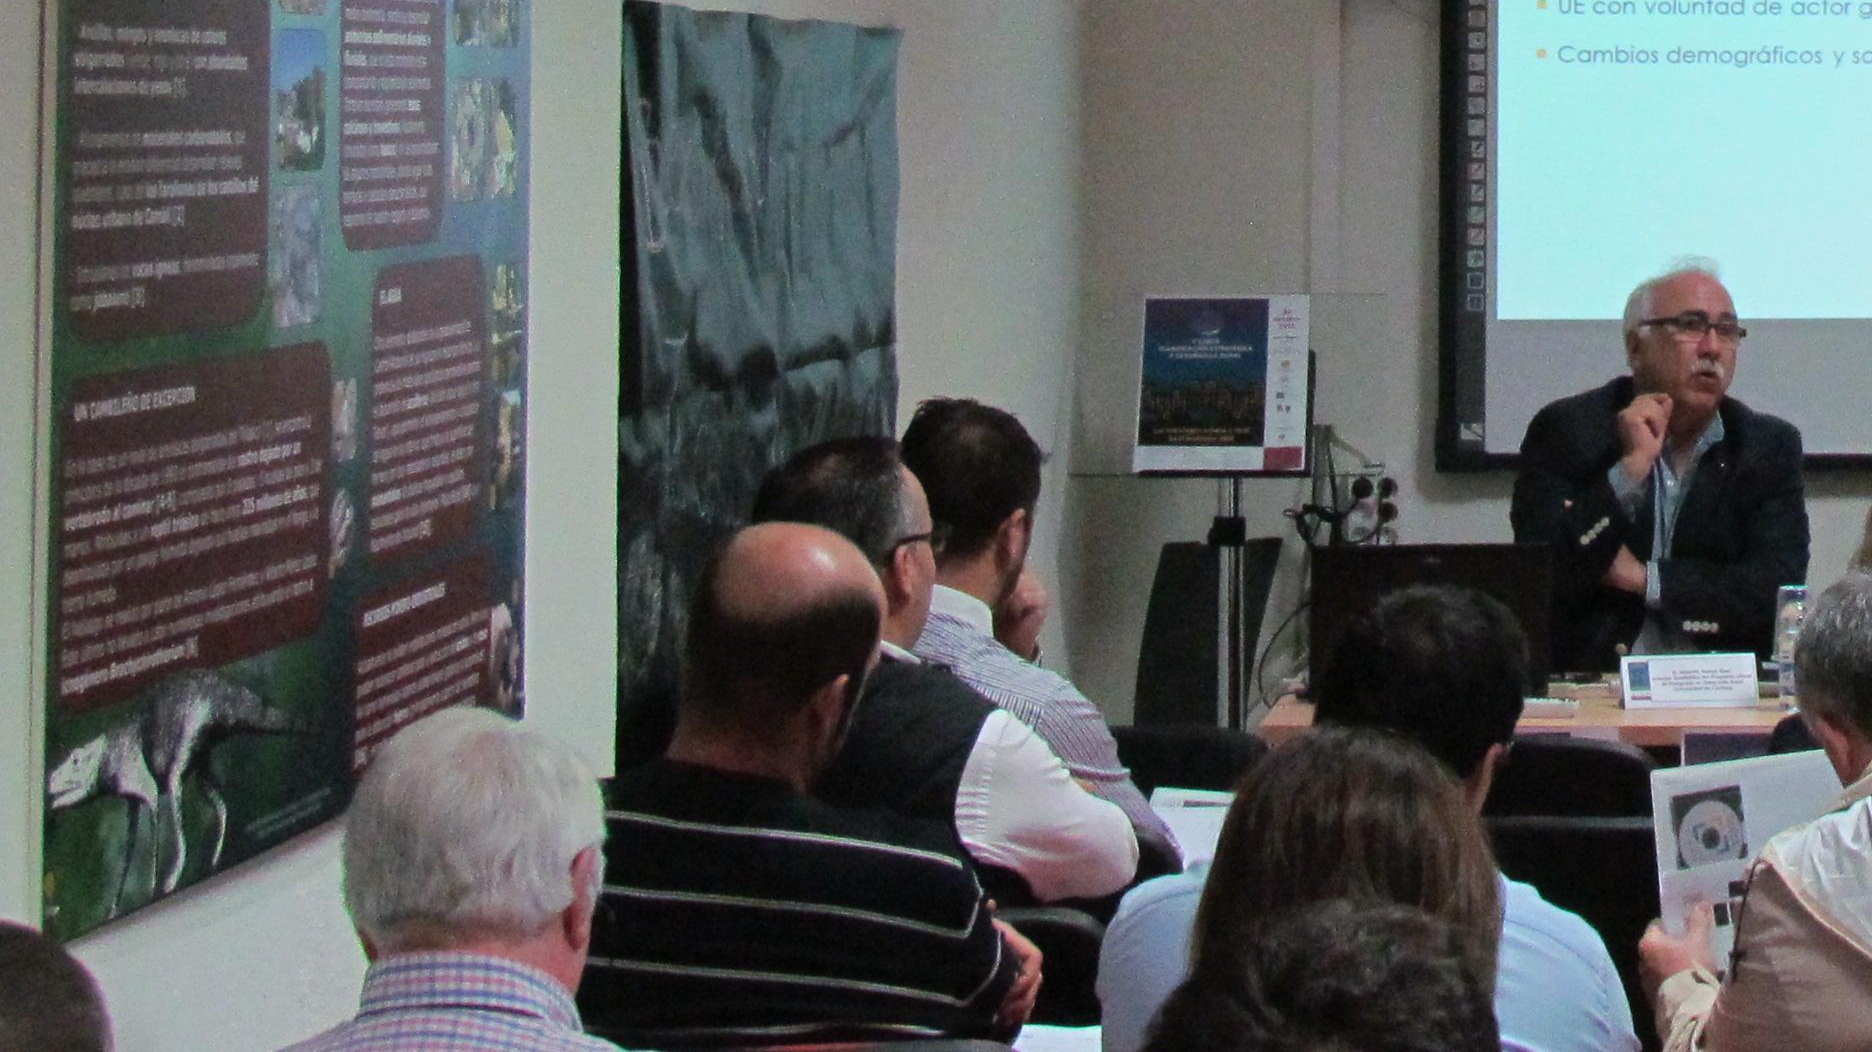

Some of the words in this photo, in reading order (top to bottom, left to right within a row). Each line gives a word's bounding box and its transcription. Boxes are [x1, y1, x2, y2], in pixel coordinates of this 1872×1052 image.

[1592, 1, 1637, 16] con
[1791, 0, 1851, 17] actor
[1558, 45, 1659, 64] Cambios
[1666, 45, 1823, 68] demográficos
[1832, 50, 1846, 68] y
